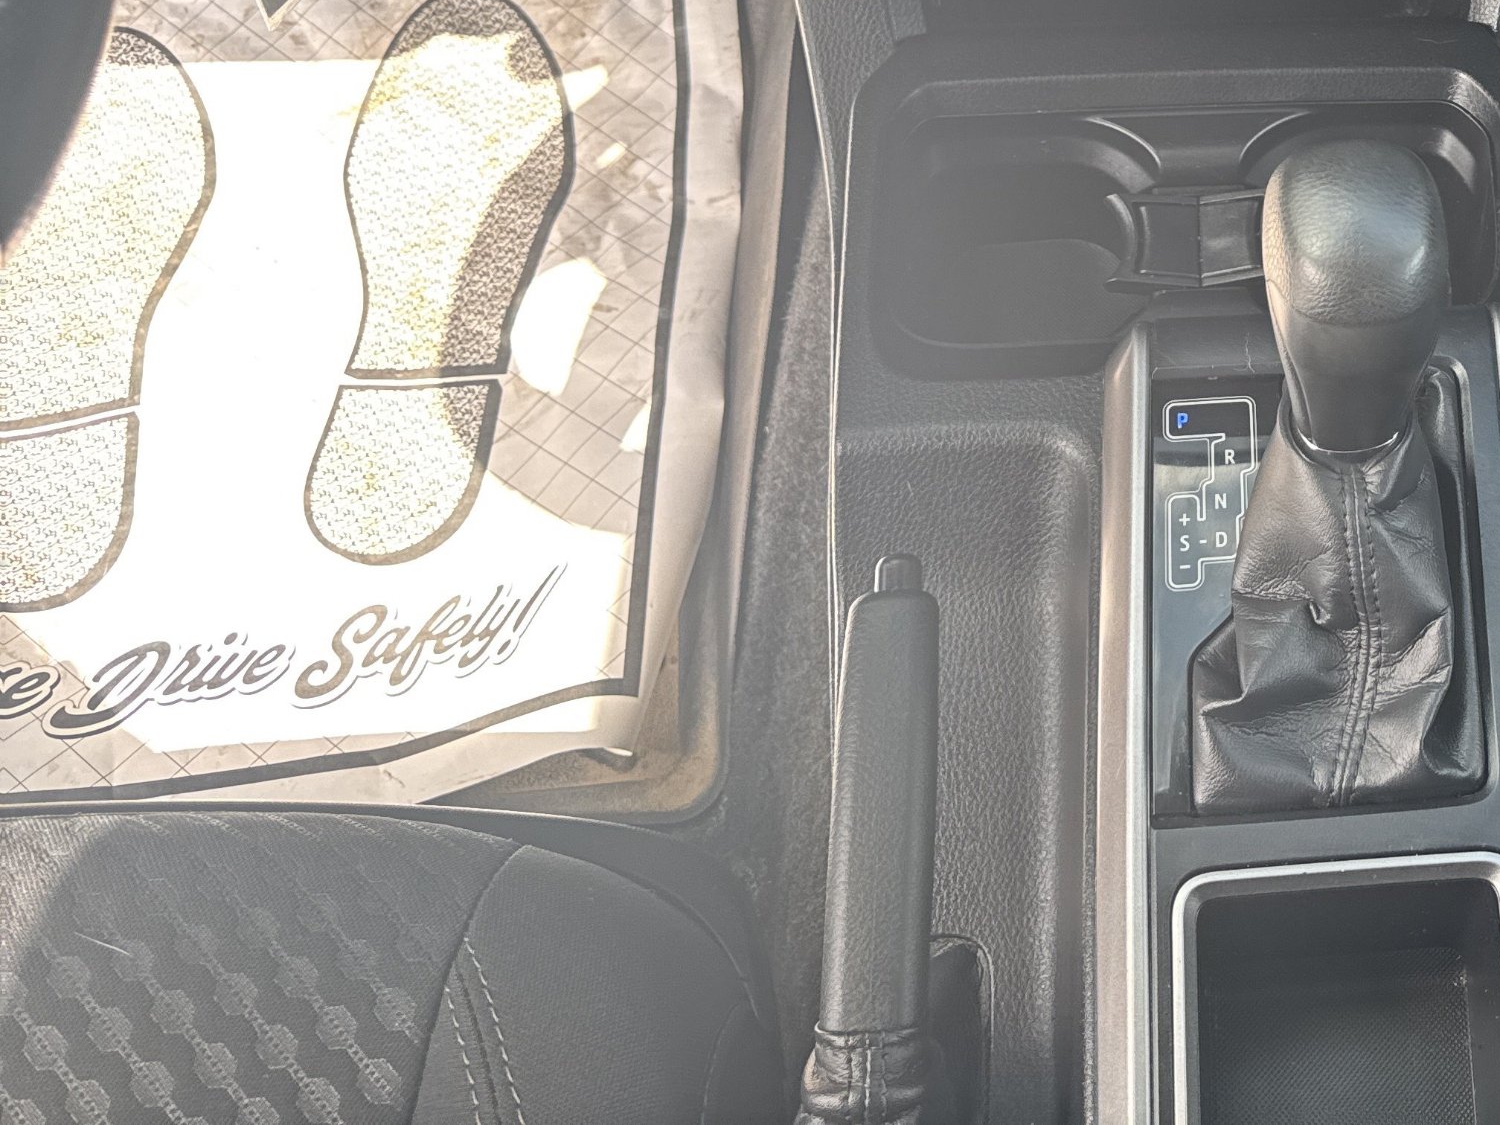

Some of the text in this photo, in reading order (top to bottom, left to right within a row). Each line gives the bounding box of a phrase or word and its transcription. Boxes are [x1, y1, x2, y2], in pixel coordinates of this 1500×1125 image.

[1176, 413, 1189, 429] P
[1224, 449, 1236, 465] R
[1214, 493, 1227, 509] N
[1179, 534, 1191, 552] S
[1215, 531, 1228, 548] D
[43, 630, 293, 737] Drive
[294, 562, 566, 705] Safely!
